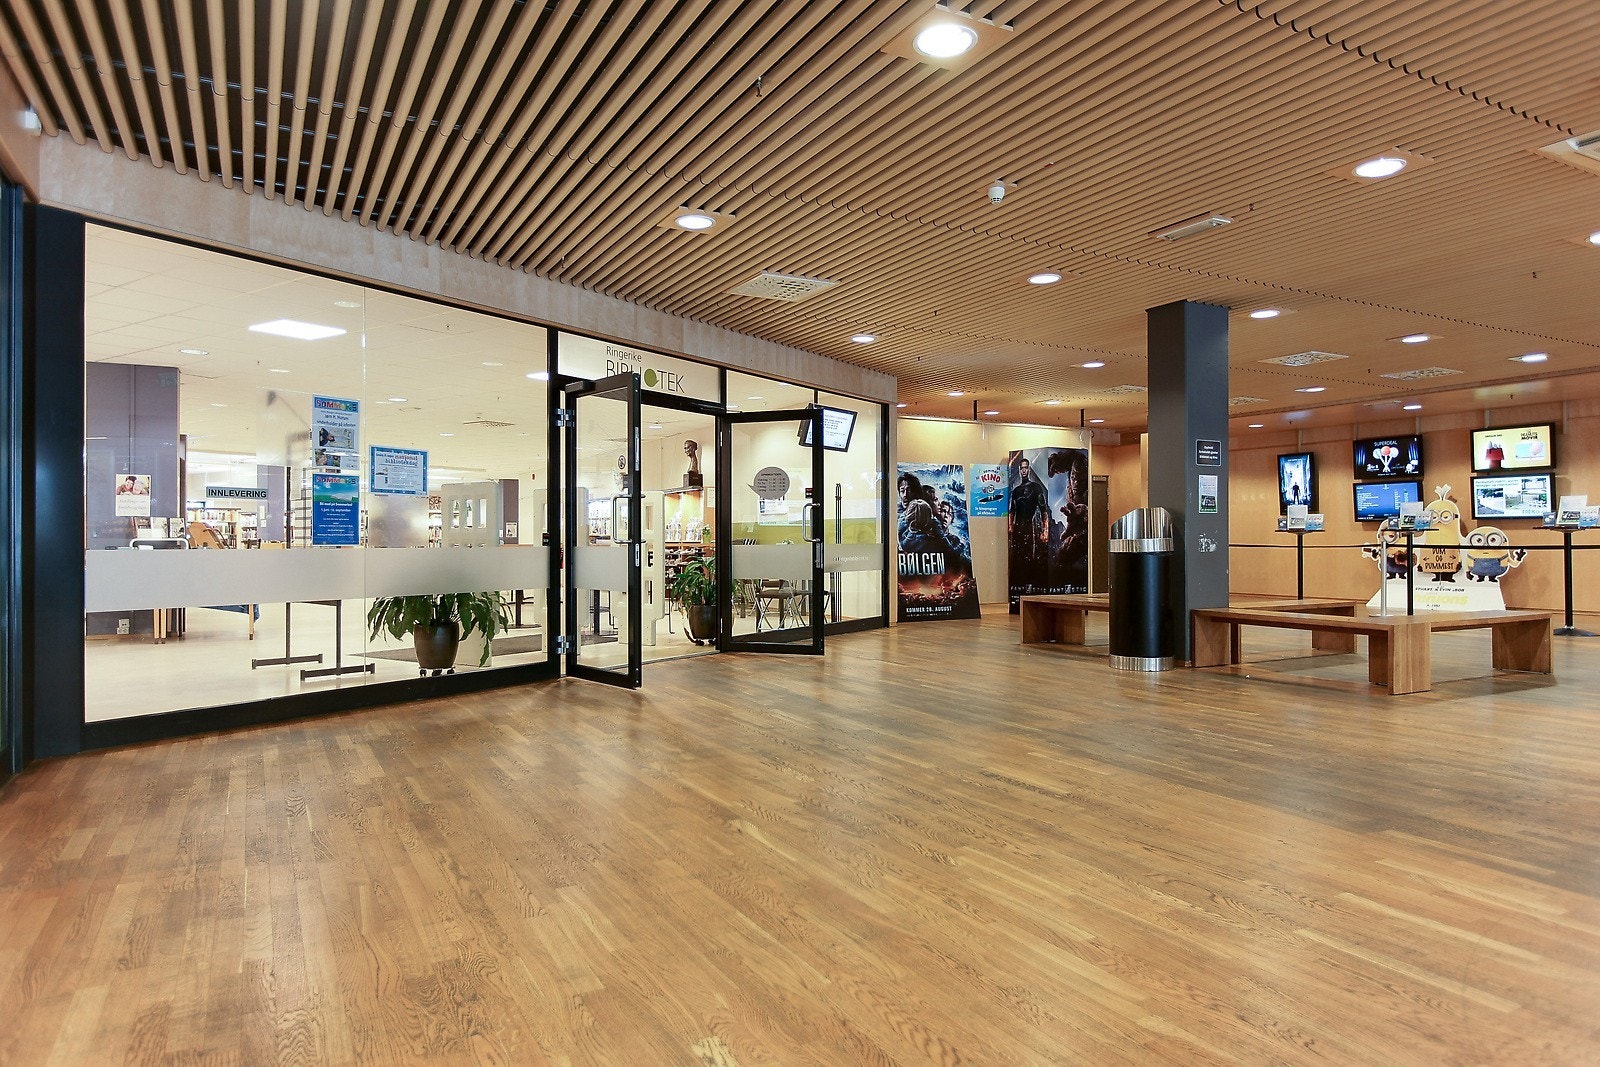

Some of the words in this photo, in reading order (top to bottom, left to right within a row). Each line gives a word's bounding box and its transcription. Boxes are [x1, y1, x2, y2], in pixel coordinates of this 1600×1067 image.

[606, 345, 642, 362] Ringerike
[980, 474, 1001, 483] KINO
[208, 489, 267, 498] INNLEVERING
[898, 552, 946, 576] BØLGEN
